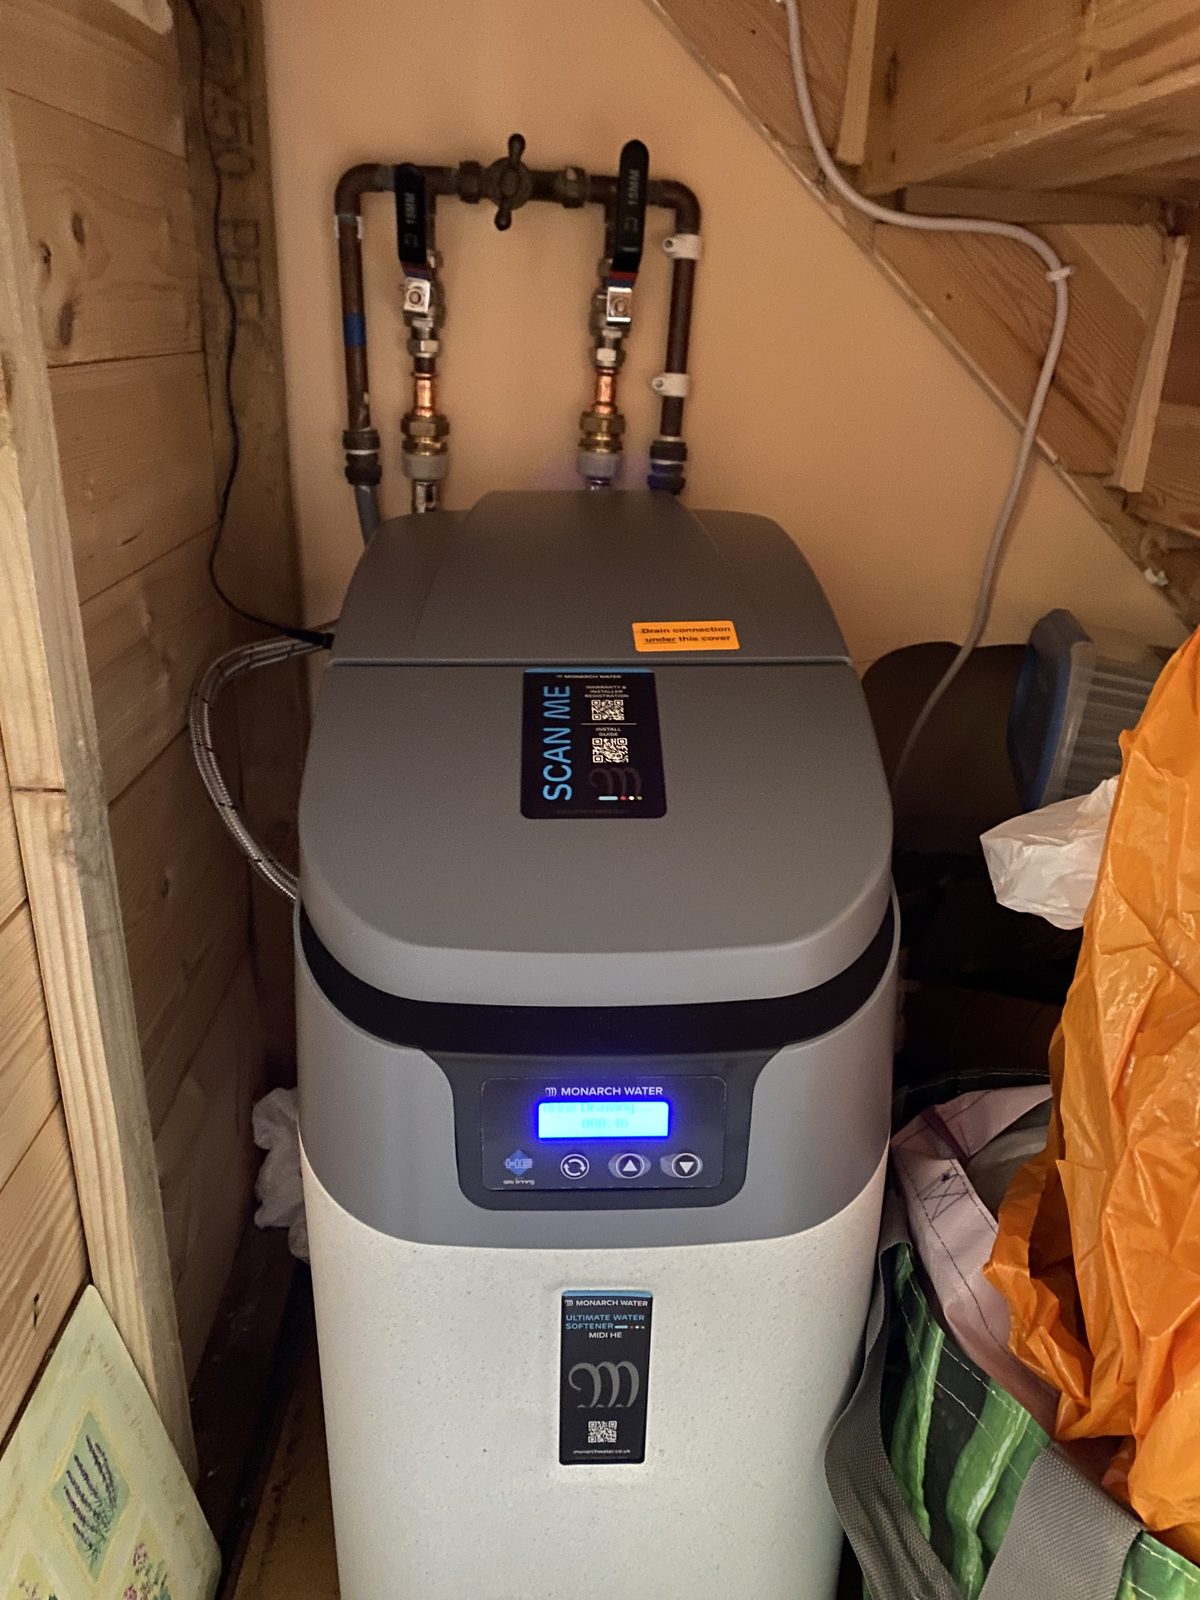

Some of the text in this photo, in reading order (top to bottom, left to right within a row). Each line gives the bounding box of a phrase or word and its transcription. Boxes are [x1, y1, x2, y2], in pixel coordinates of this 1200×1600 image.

[641, 626, 731, 634] Drain connection
[645, 635, 677, 644] under
[543, 685, 572, 801] SCAN ME
[561, 1086, 664, 1096] MONARCH WATER
[575, 1299, 649, 1307] MONARCH WATER
